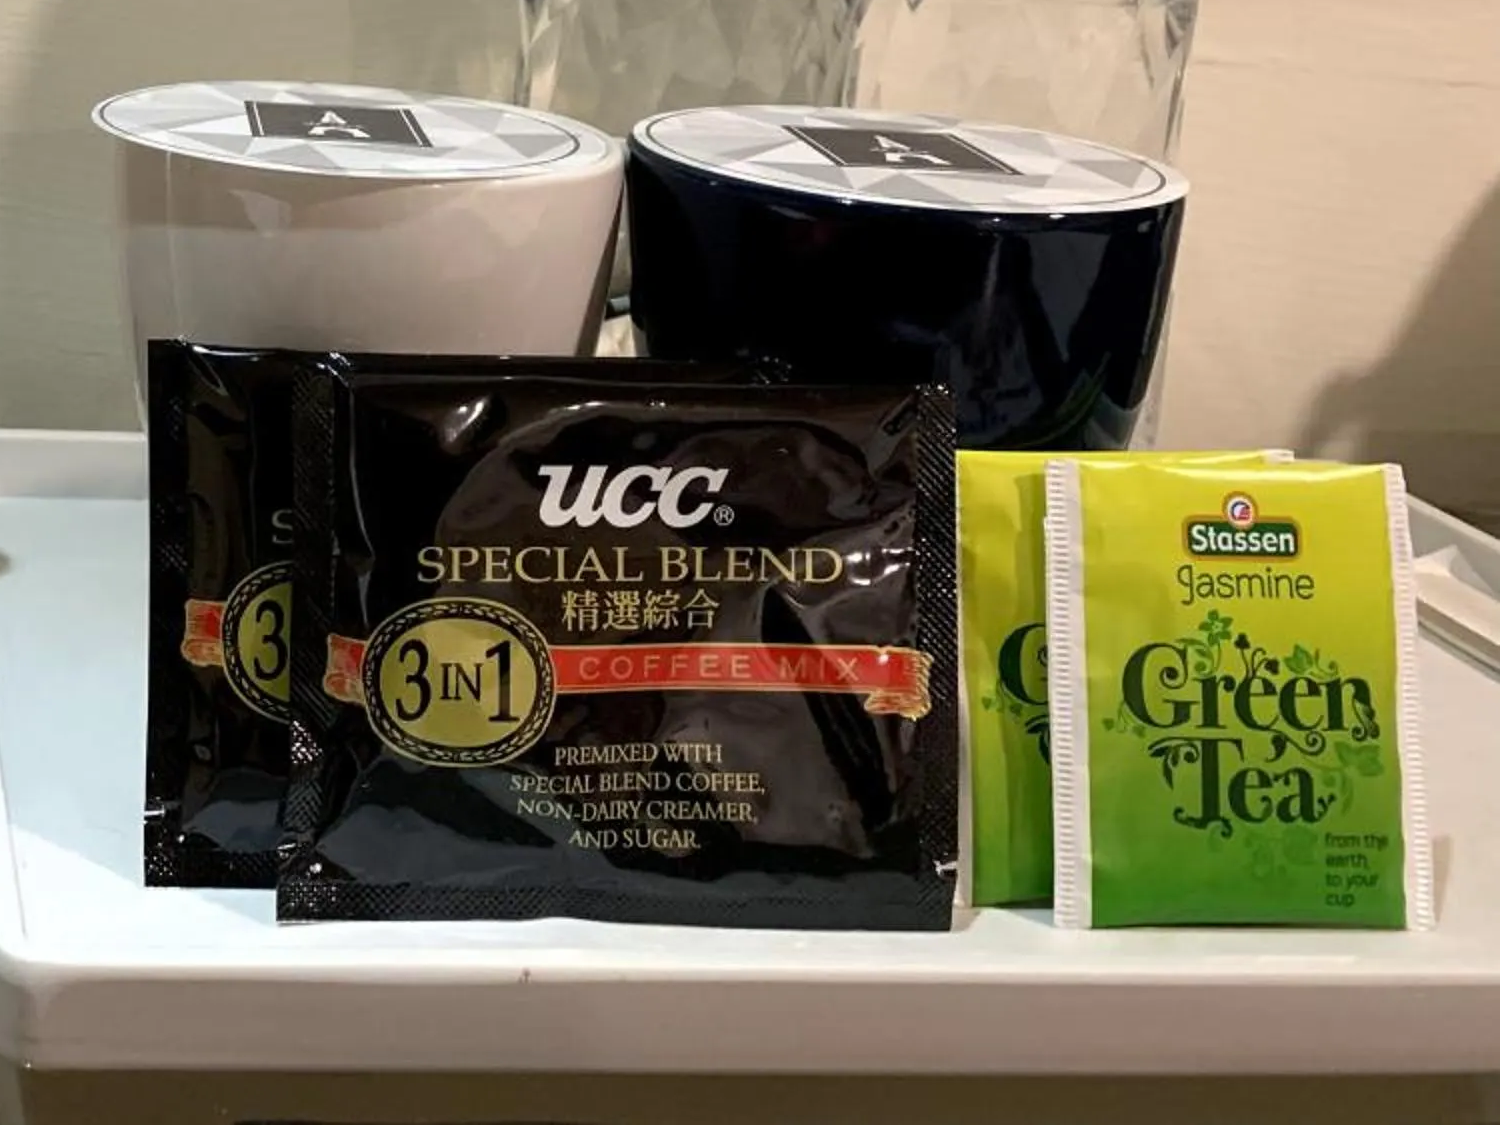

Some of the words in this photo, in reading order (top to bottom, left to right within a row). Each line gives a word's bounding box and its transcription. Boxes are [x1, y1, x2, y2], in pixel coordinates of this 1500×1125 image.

[1191, 524, 1296, 553] Stassen
[417, 546, 646, 583] SPECIAL
[661, 546, 844, 584] BLEND
[561, 588, 720, 632] 精選綜合
[578, 654, 752, 680] COFFEE
[779, 655, 861, 683] MIX
[1122, 642, 1380, 741] Green
[555, 743, 659, 766] PREMIXED
[661, 743, 723, 764] WITH
[510, 775, 595, 794] SPECIAL
[599, 772, 671, 792] BLEND
[675, 772, 766, 795] COFFEE,
[1148, 736, 1336, 837] Tea
[516, 798, 643, 822] NON-DAIRY
[569, 829, 618, 849] AND
[1325, 832, 1361, 849] from
[1364, 834, 1389, 851] the
[1325, 873, 1343, 887] to
[1346, 873, 1379, 892] your
[1325, 893, 1356, 908] cup
